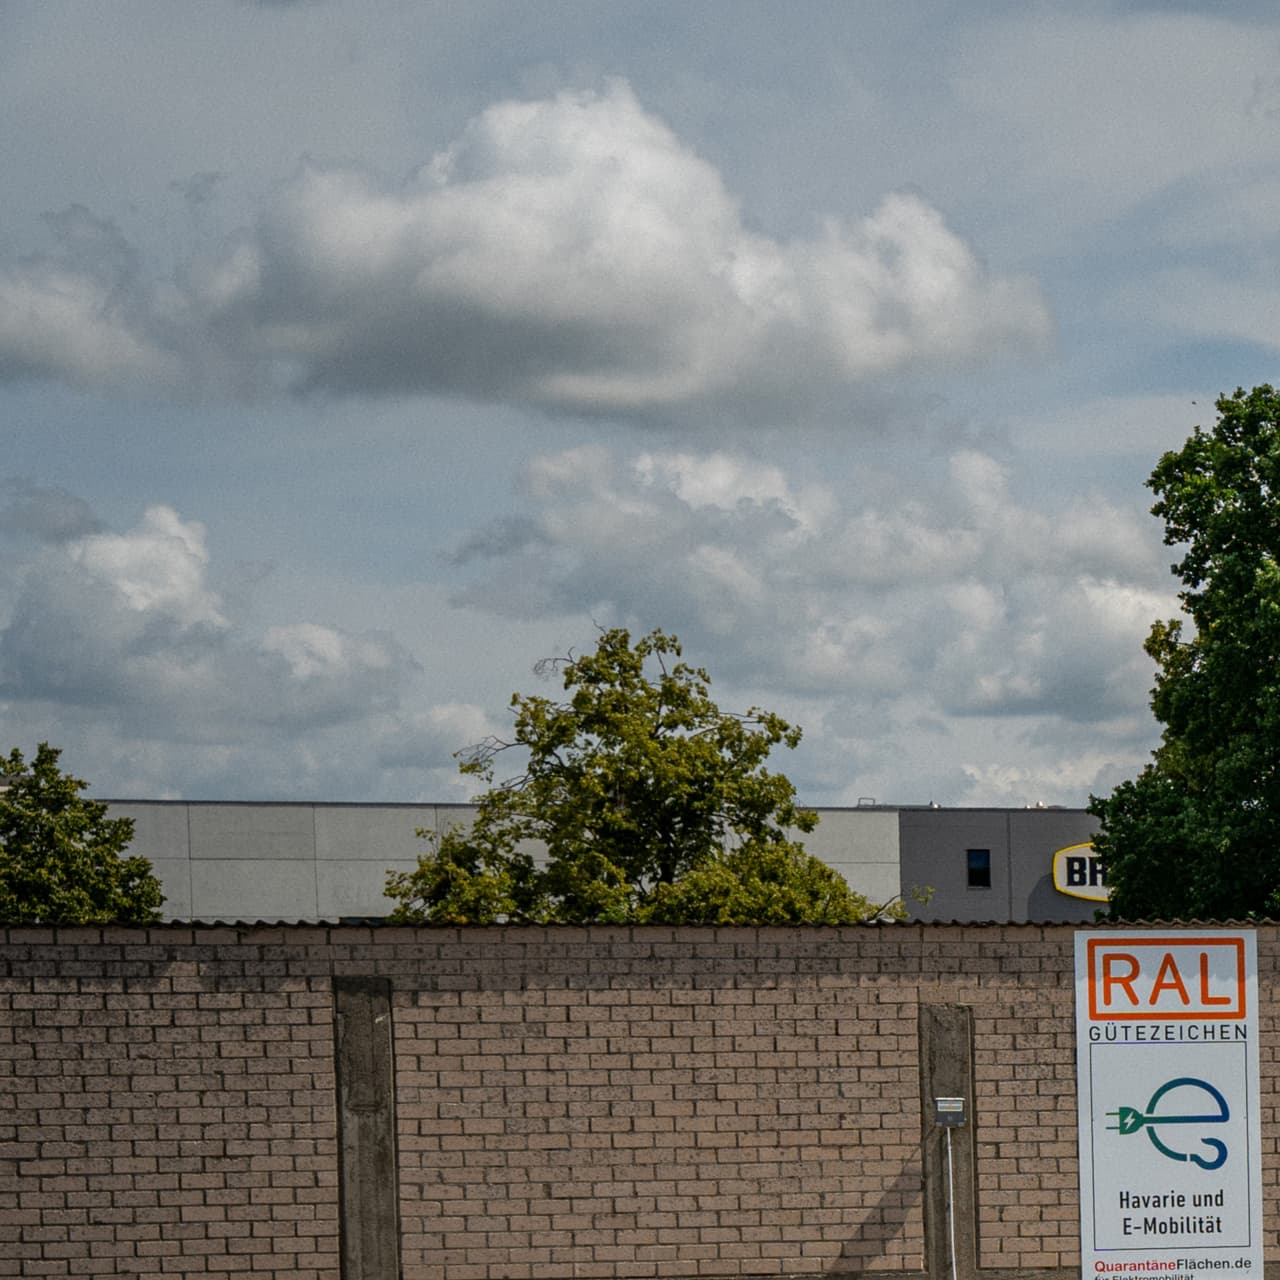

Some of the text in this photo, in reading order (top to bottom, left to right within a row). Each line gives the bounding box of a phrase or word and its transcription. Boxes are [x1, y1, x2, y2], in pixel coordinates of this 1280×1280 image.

[1102, 952, 1232, 1007] RAL
[1089, 1022, 1248, 1042] GÜTEZEICHEN
[1119, 1189, 1225, 1209] Havarie und
[1123, 1215, 1222, 1236] E-Mobilität
[1094, 1256, 1253, 1274] QuarantäneFlächen.de
